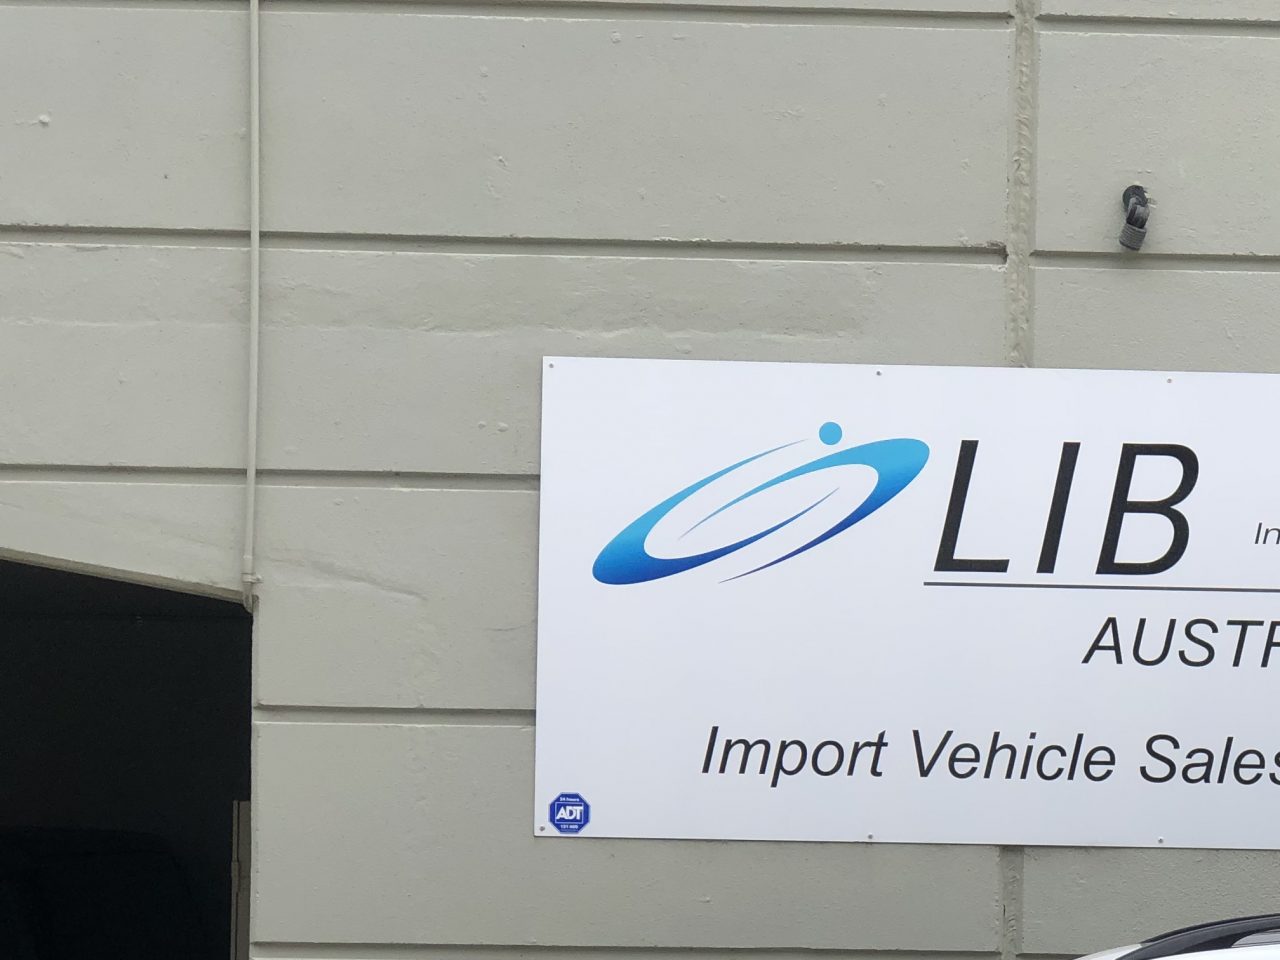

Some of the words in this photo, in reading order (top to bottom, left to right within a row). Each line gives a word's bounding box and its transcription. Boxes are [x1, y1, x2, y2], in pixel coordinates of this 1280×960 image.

[933, 439, 1200, 576] LIB
[701, 725, 889, 788] Import
[912, 729, 1116, 782] Vehicle
[556, 805, 584, 820] ADT
